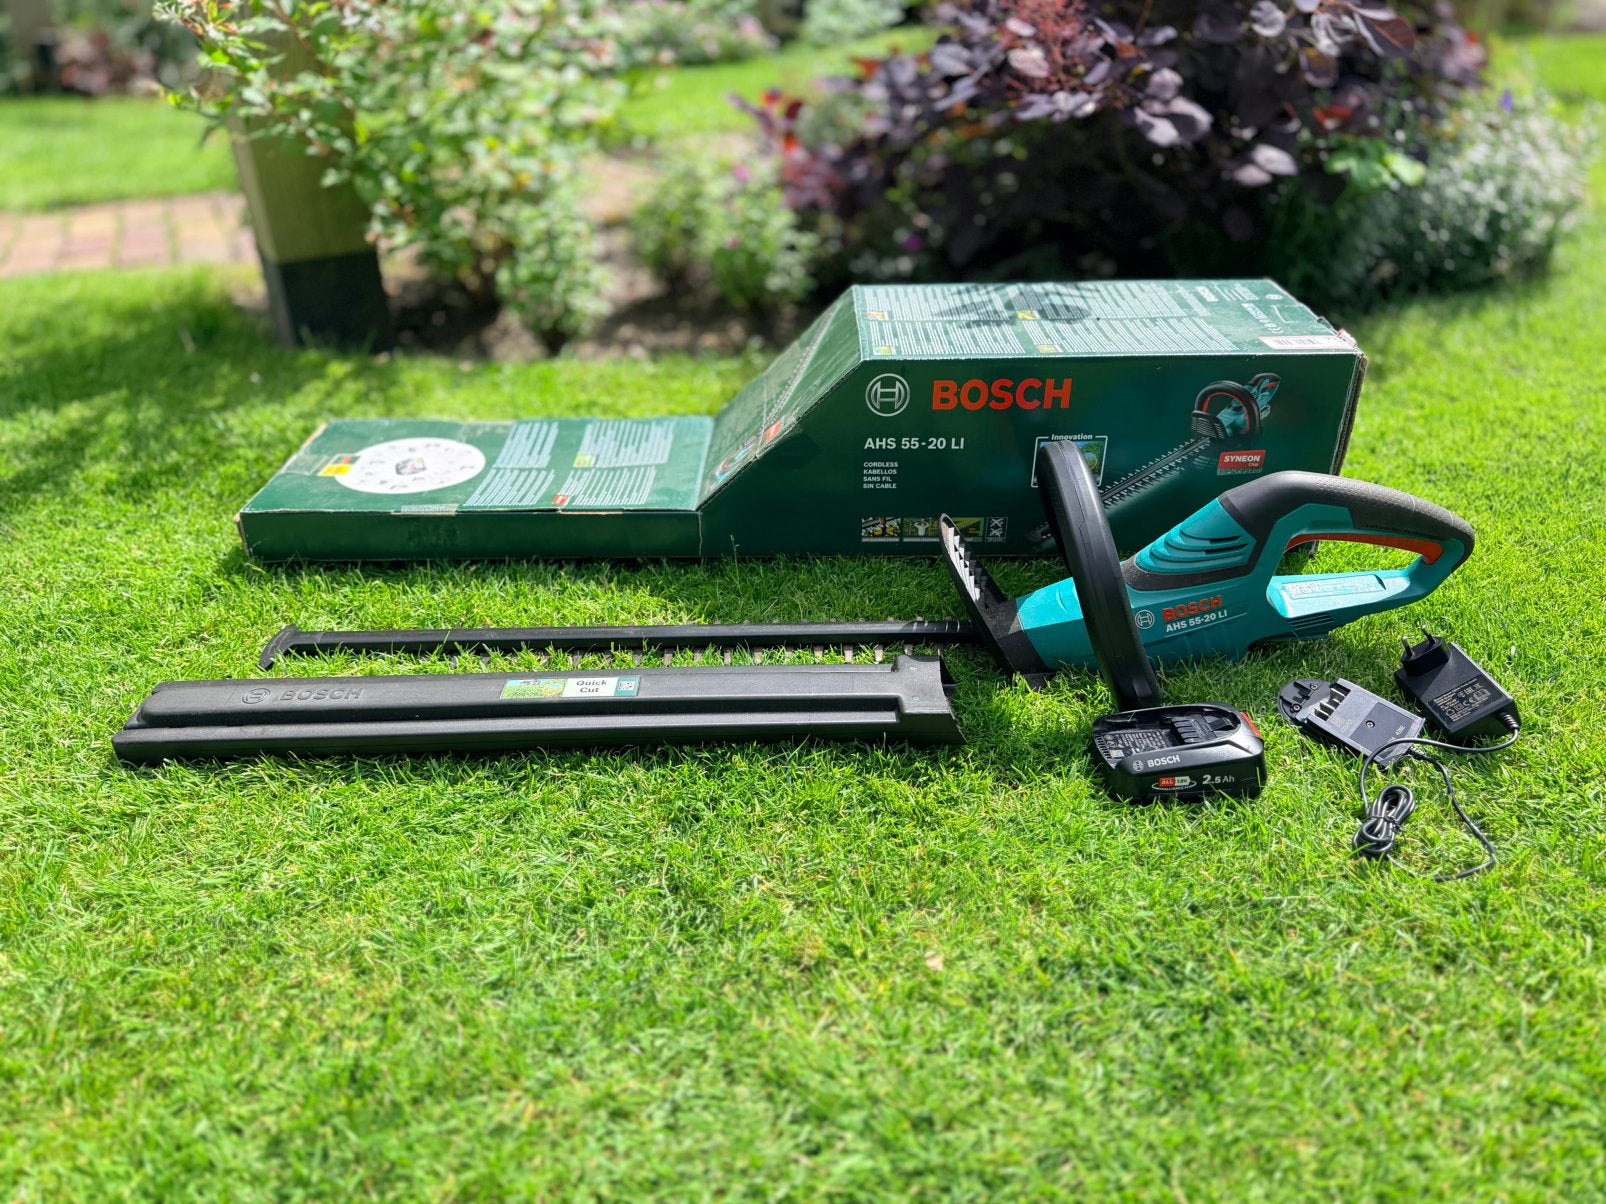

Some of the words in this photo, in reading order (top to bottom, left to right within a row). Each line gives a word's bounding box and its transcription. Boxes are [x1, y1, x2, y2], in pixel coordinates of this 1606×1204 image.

[932, 378, 1073, 411] BOSCH
[863, 437, 897, 450] AHS
[951, 437, 965, 450] LI
[1224, 455, 1261, 463] SYNEON
[1163, 595, 1223, 623] BOSCH
[1166, 620, 1188, 633] AHS
[1189, 613, 1217, 627] 55-20
[1218, 609, 1228, 619] LI
[280, 688, 365, 700] BOSCH
[1147, 754, 1181, 768] BOSCH
[1202, 774, 1222, 785] 2.5
[1222, 775, 1235, 783] Ah
